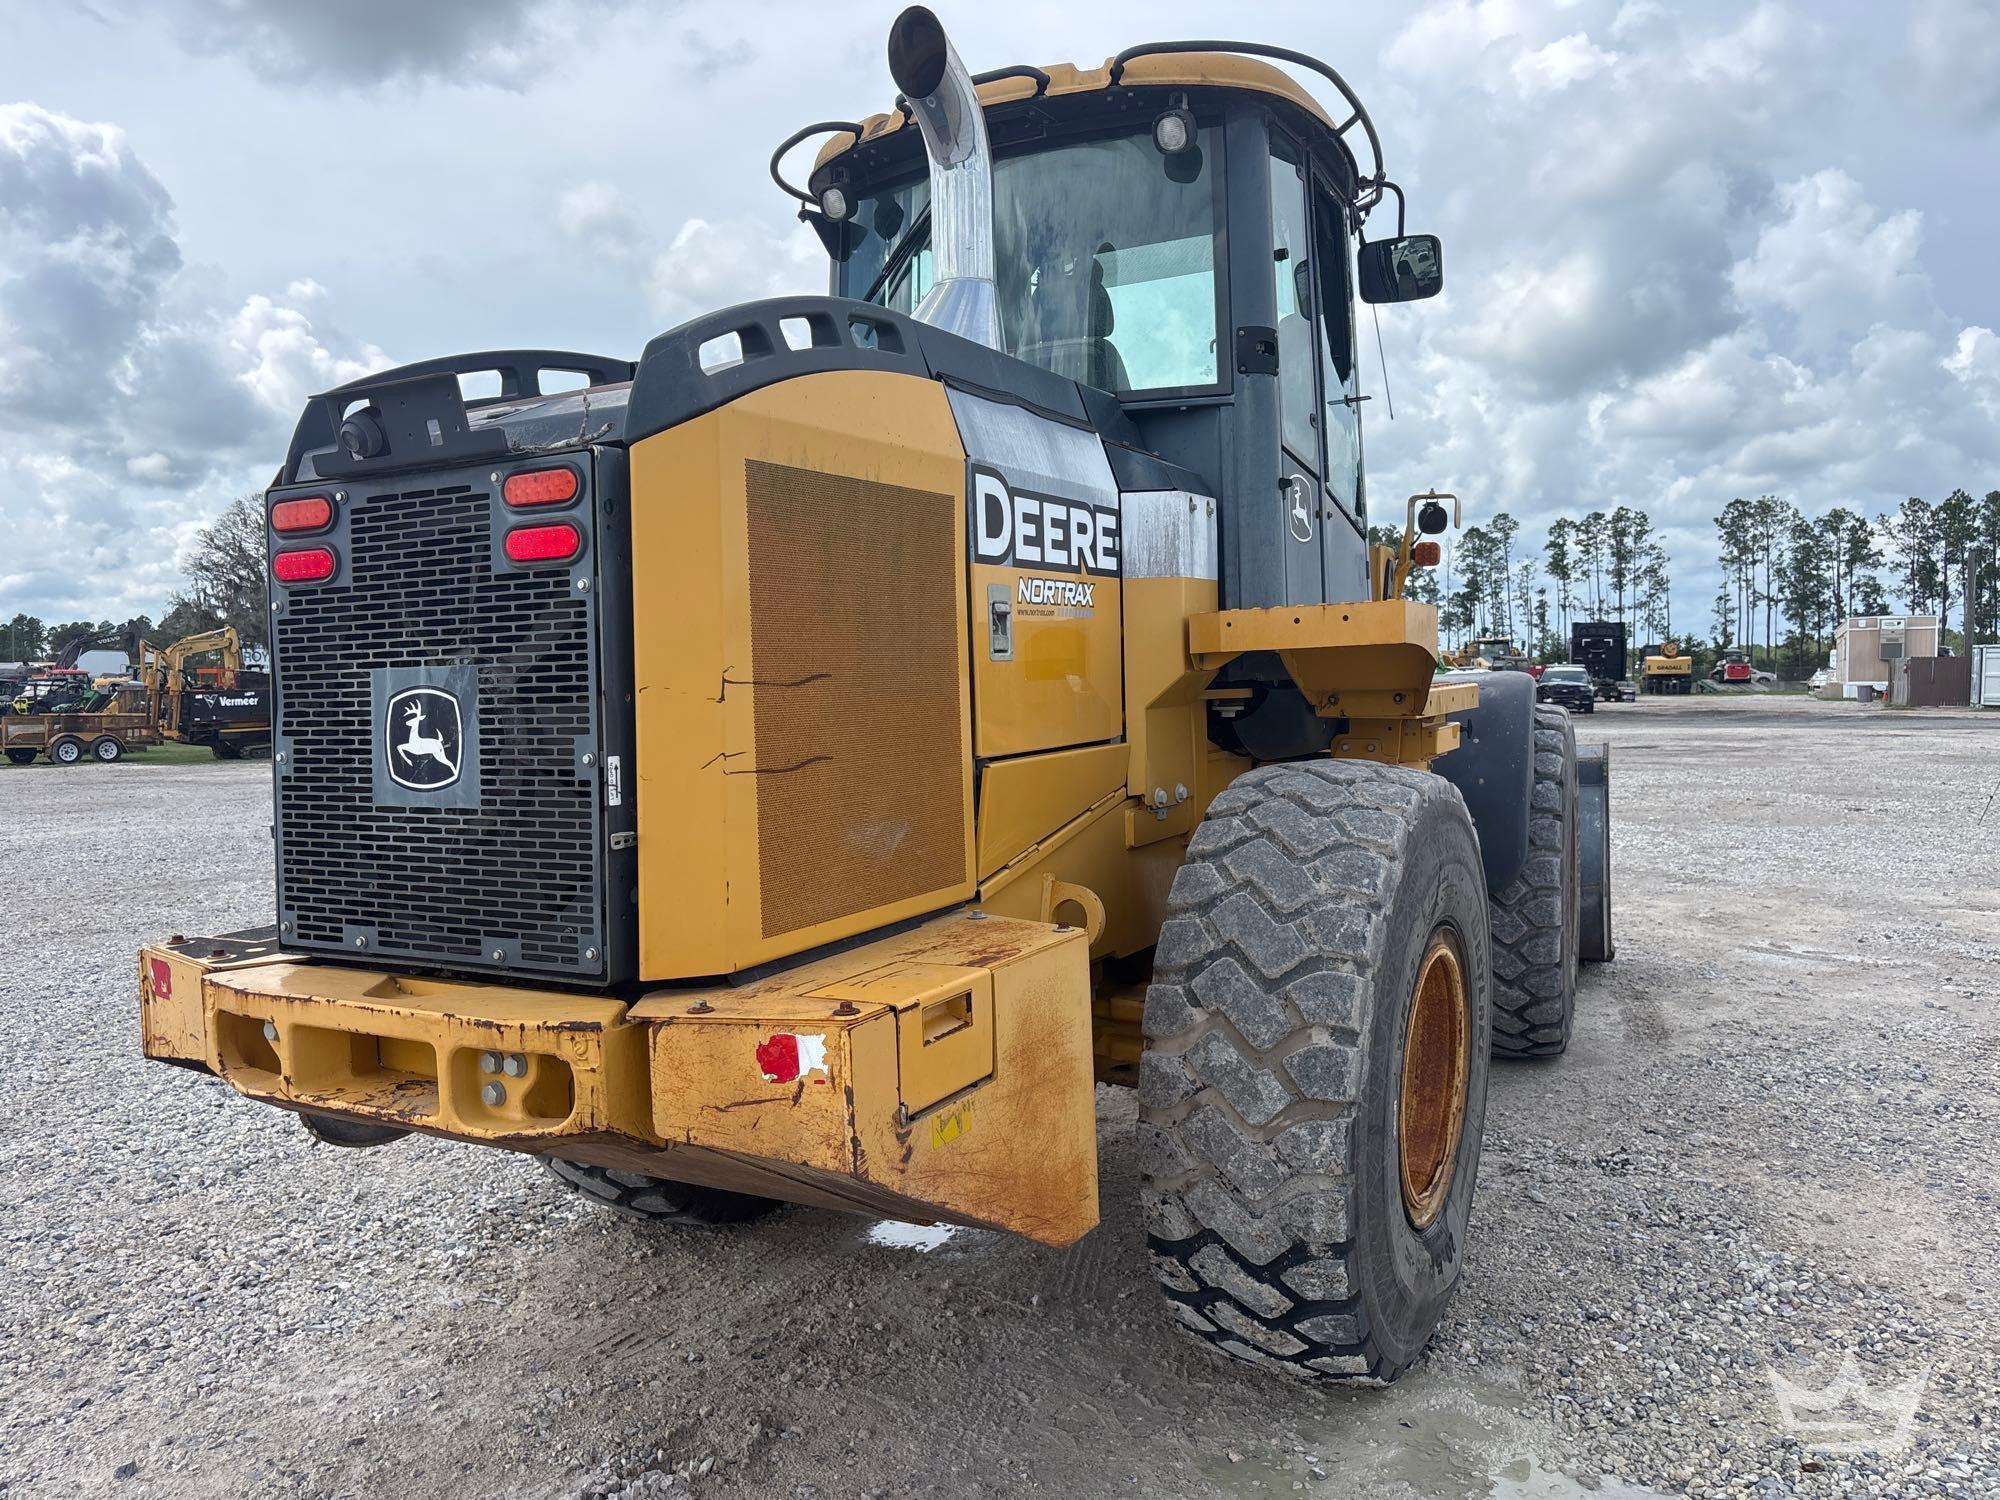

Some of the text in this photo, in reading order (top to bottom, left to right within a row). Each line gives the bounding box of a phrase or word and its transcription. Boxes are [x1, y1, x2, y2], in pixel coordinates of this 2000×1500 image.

[975, 472, 1118, 571] DEERE
[1017, 576, 1095, 608] NORTRAX
[97, 635, 121, 645] VOLVO
[219, 696, 259, 707] Vermeer
